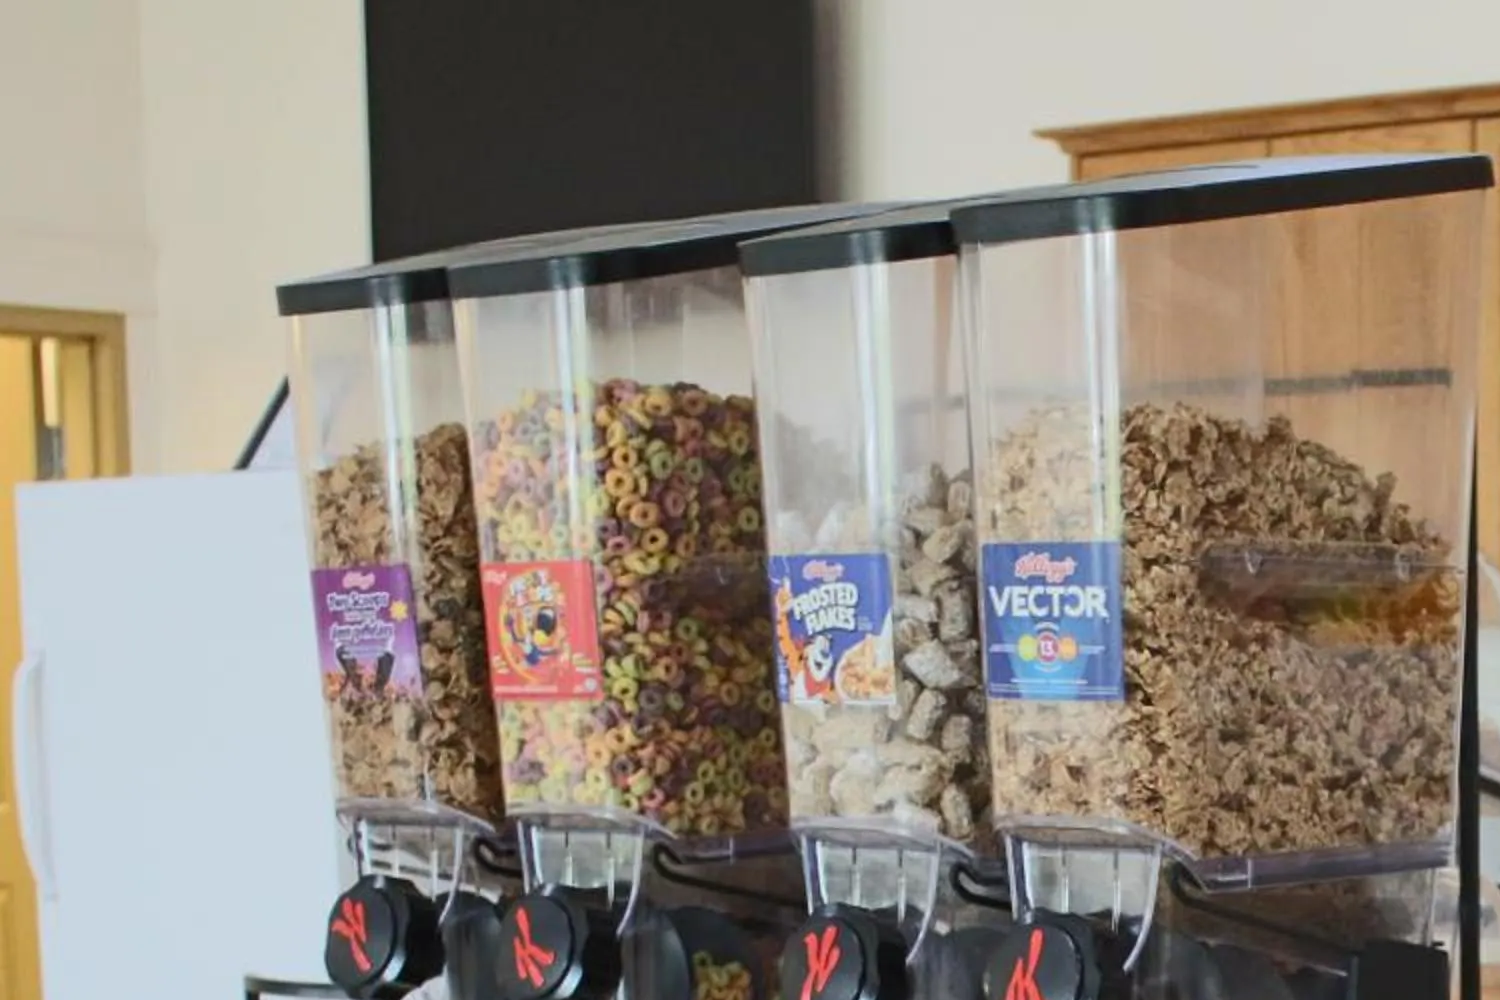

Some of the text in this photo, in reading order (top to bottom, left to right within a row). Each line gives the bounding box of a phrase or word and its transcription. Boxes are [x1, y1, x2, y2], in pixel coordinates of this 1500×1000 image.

[793, 582, 858, 620] FROSTED
[988, 585, 1109, 618] VECTOR
[804, 605, 856, 635] FLAKES
[513, 908, 555, 987] K
